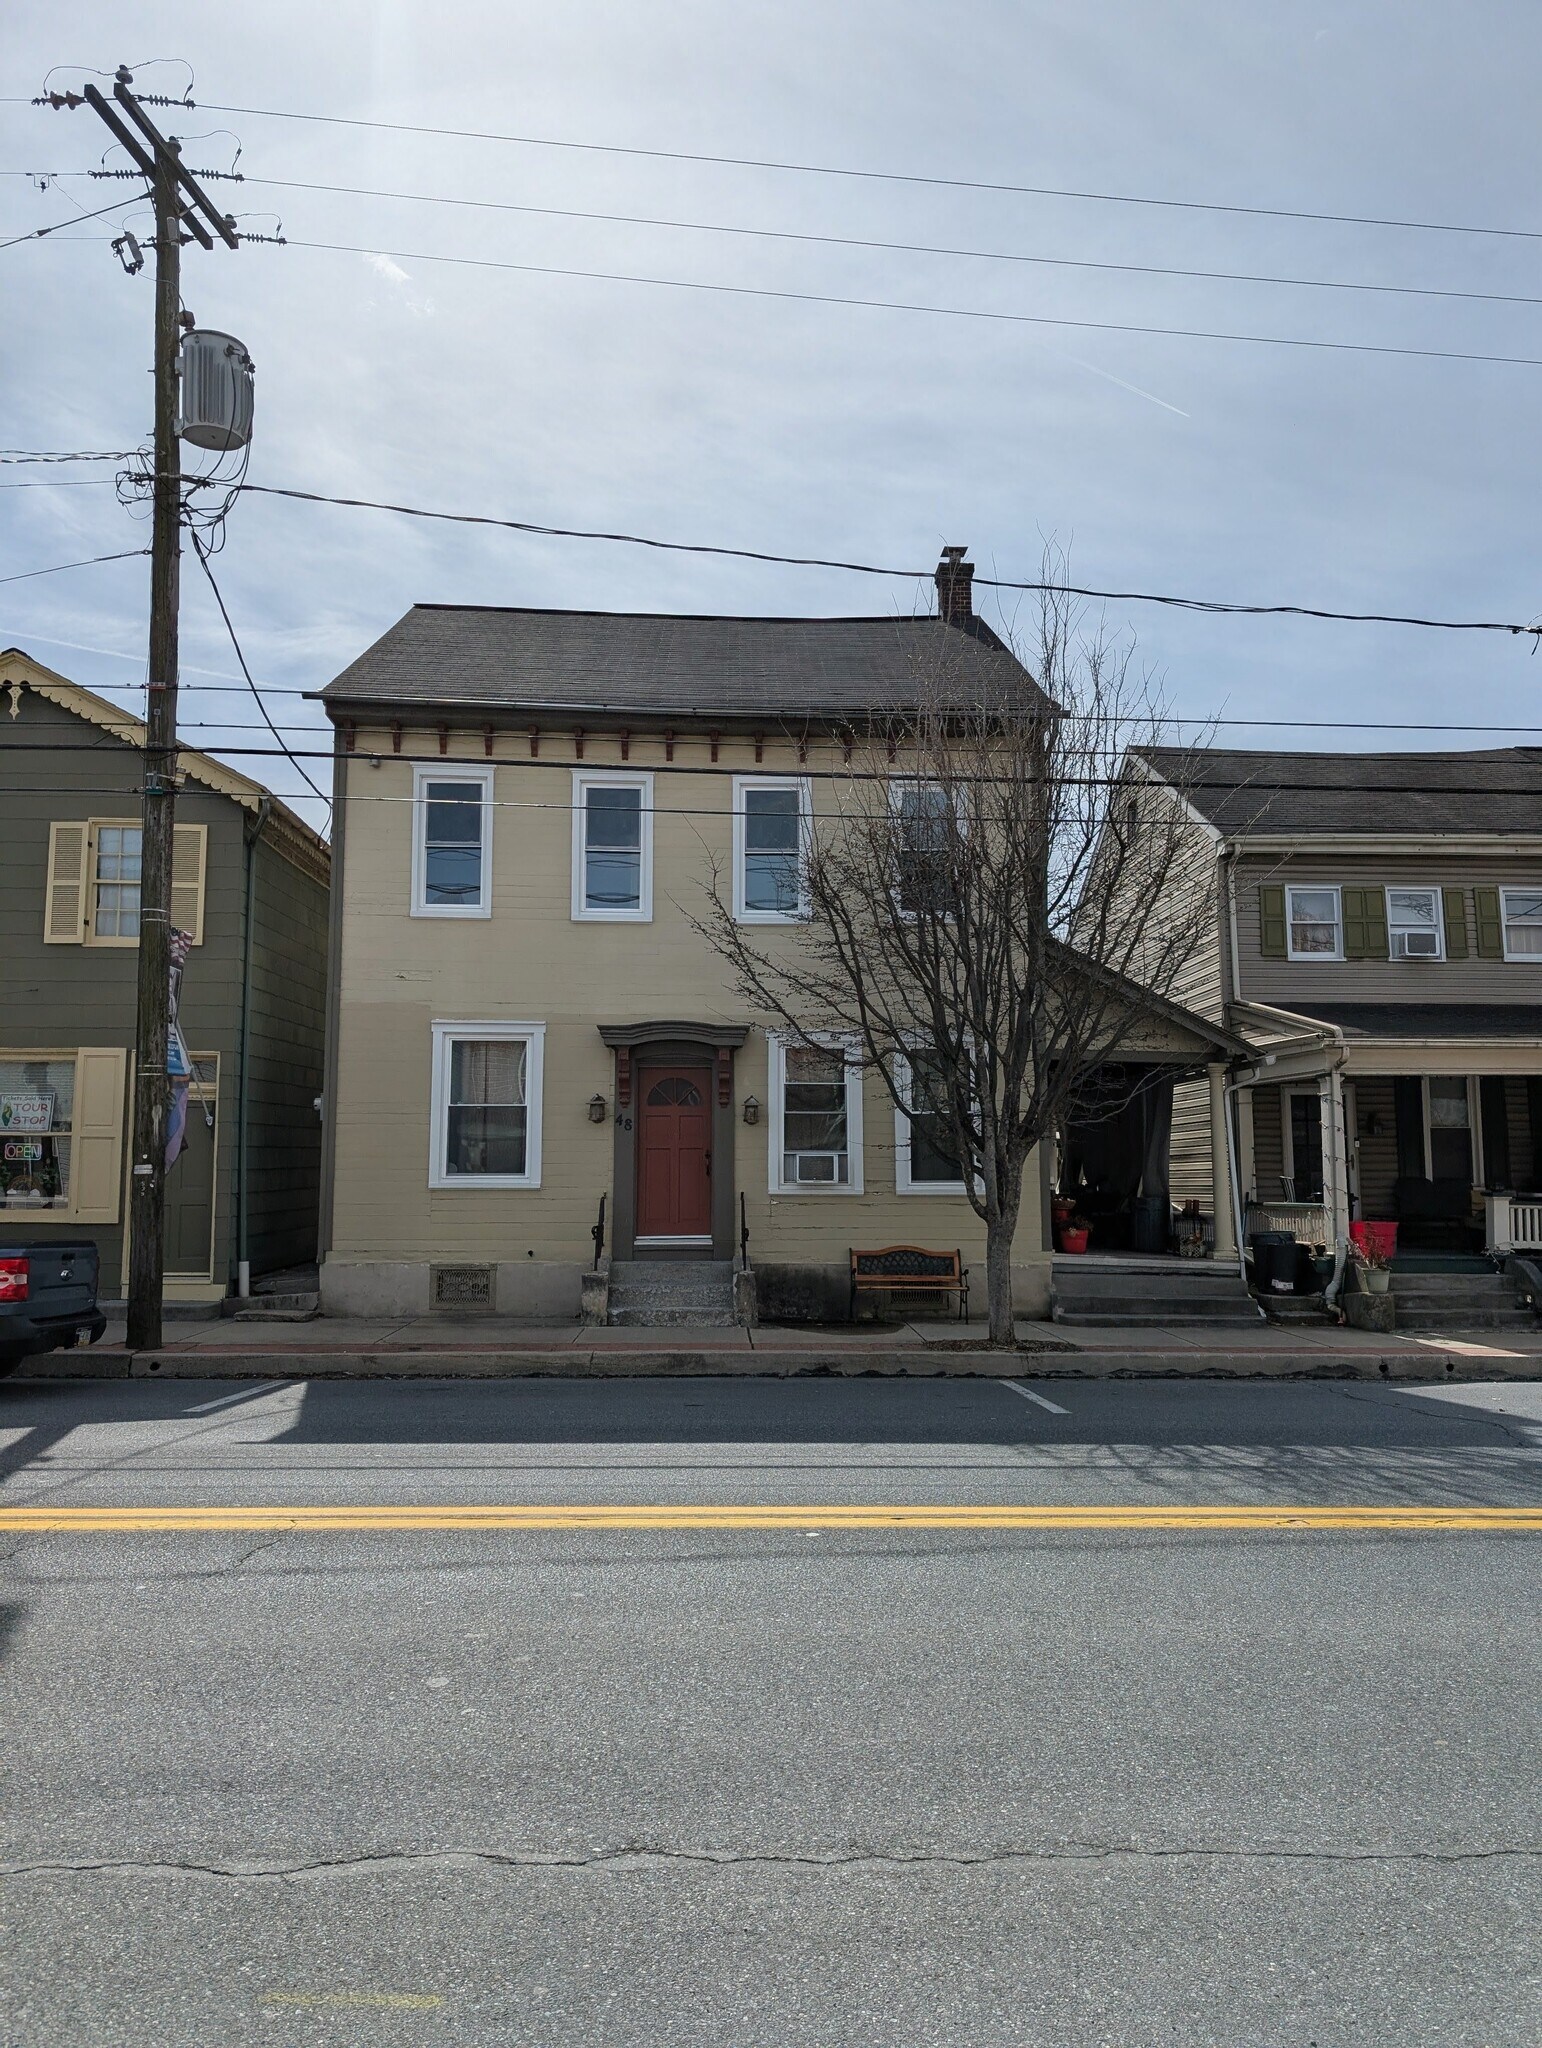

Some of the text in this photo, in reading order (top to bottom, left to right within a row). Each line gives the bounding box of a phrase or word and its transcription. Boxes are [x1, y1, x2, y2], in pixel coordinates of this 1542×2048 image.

[13, 1103, 48, 1112] TOUR
[12, 1116, 46, 1125] STOP
[615, 1113, 632, 1131] 48
[6, 1145, 40, 1158] OPEN
